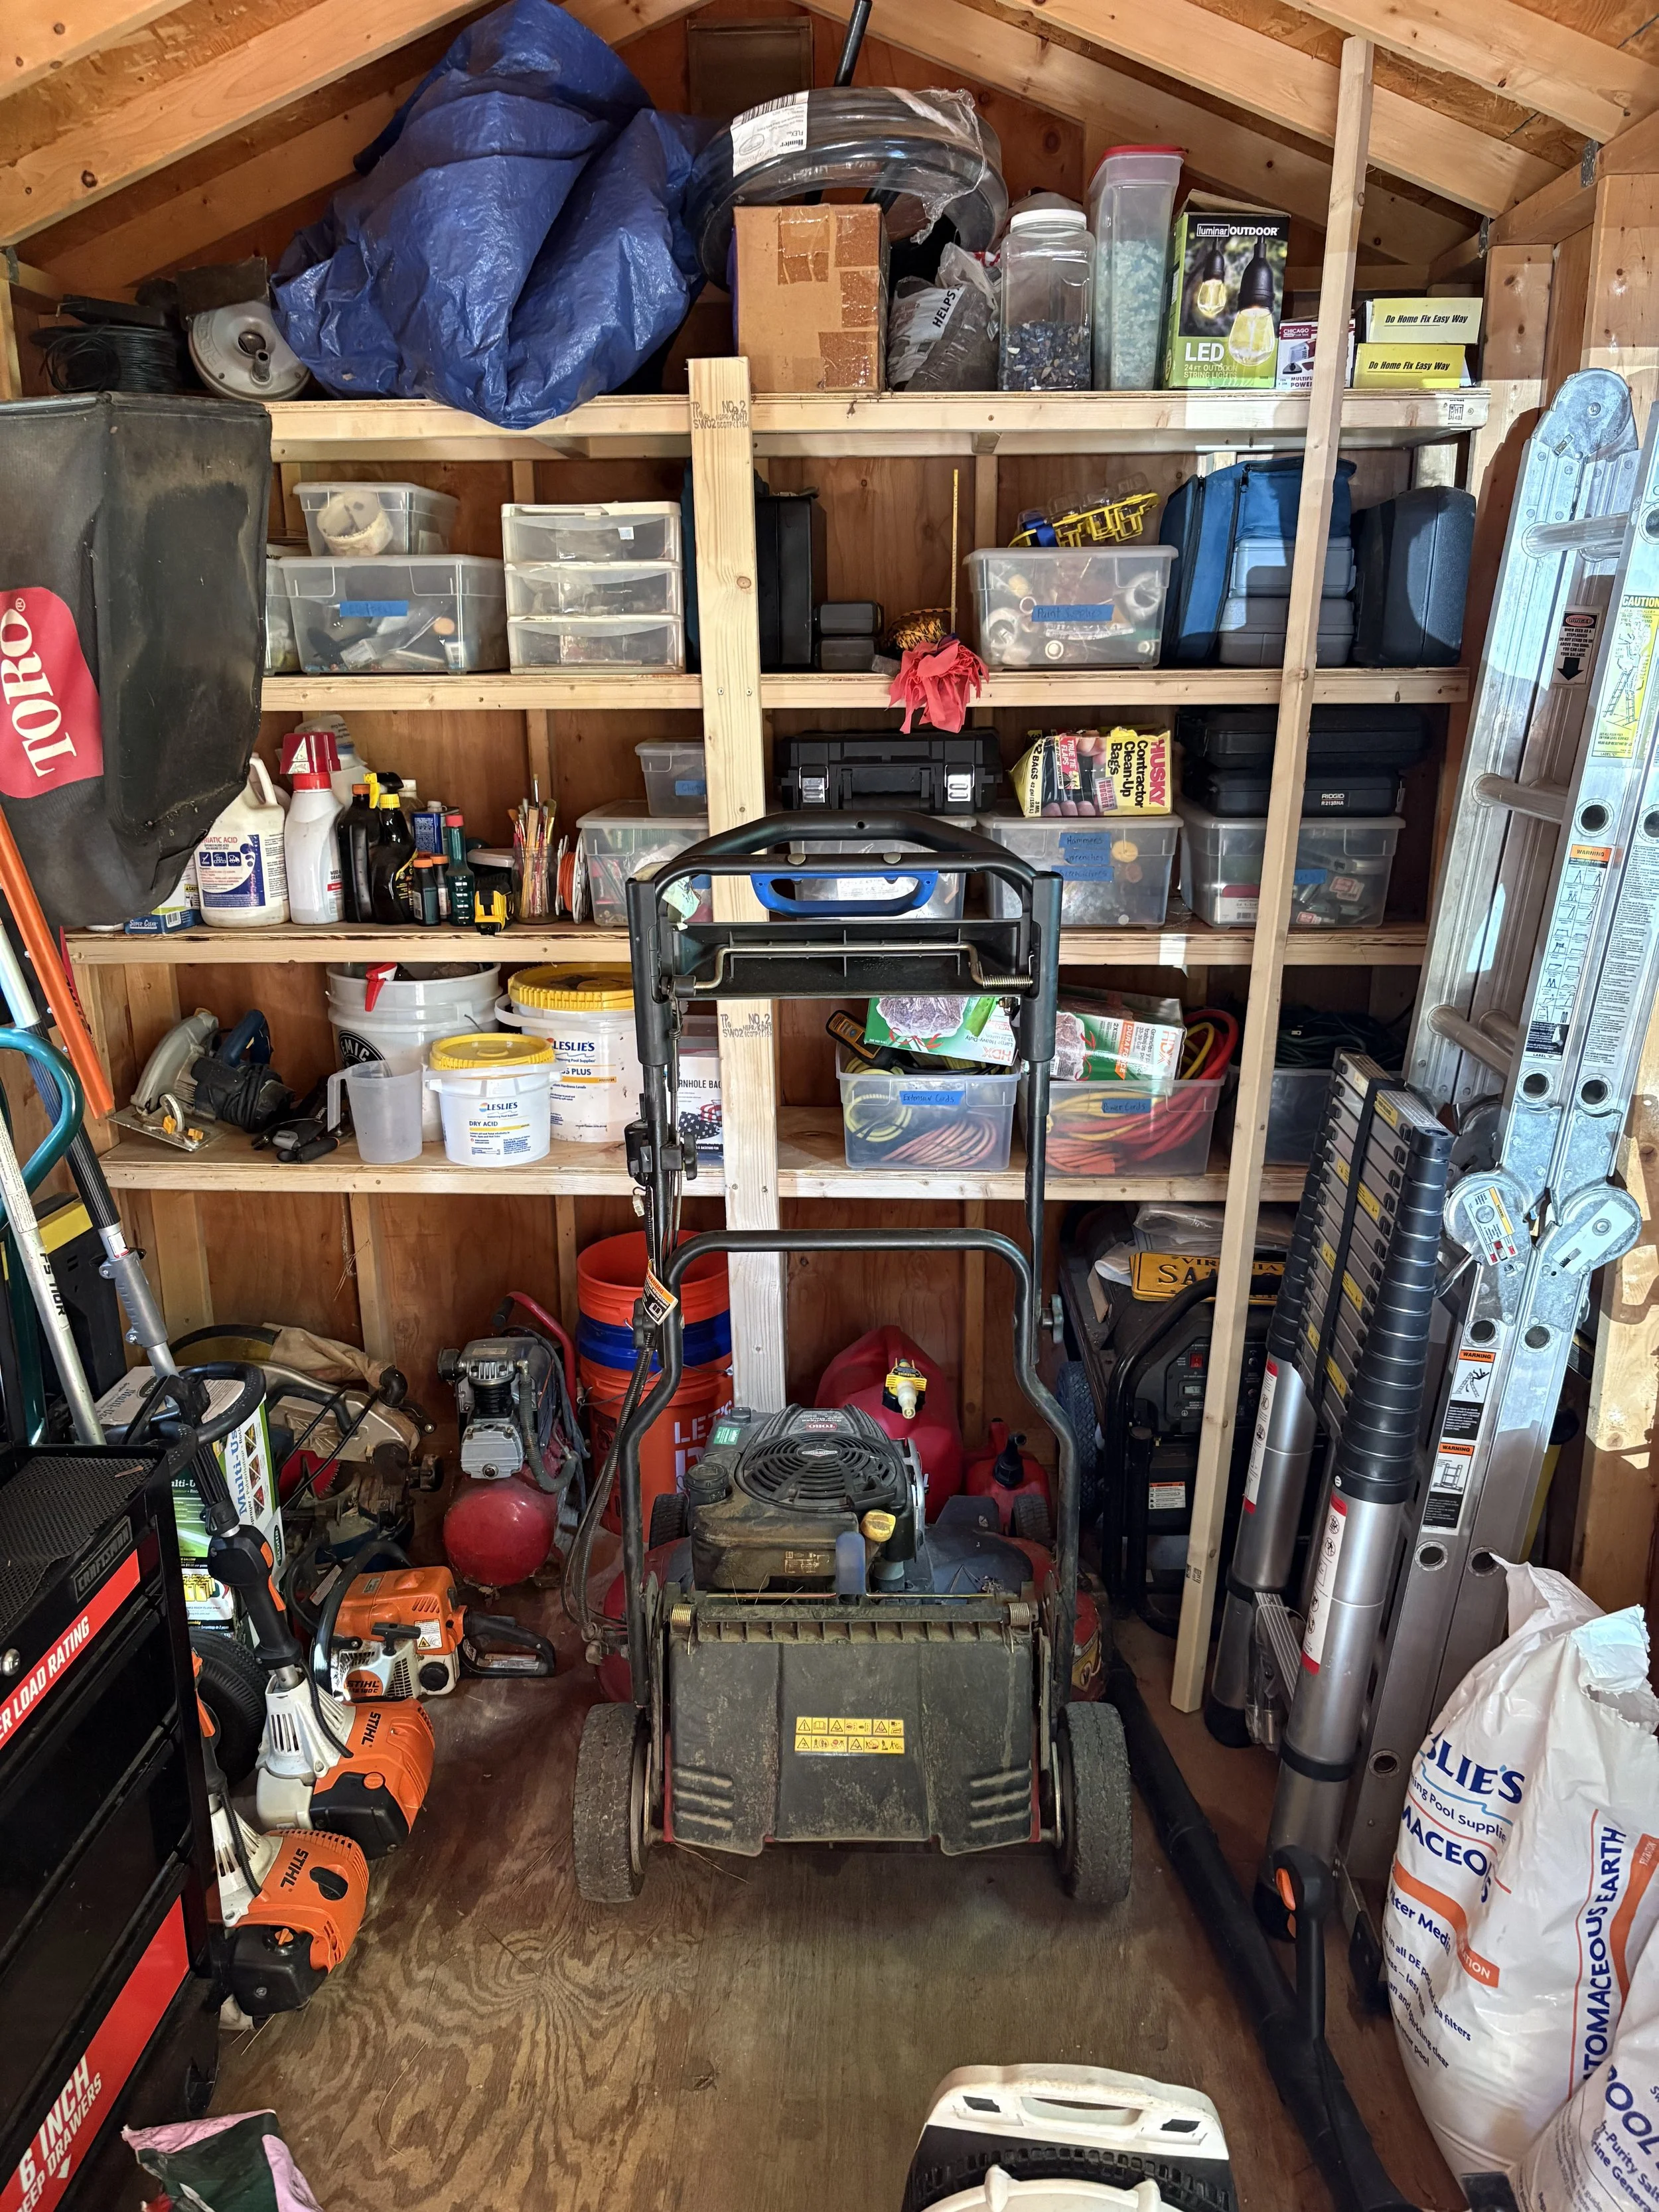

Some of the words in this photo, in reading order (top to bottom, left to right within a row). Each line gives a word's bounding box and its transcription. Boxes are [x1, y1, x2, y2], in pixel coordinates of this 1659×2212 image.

[1198, 226, 1228, 236] luminar
[1229, 226, 1278, 236] OUTDOOR
[932, 290, 956, 328] HELPS
[1433, 315, 1450, 324] Easy
[1451, 315, 1468, 324] Way
[1185, 342, 1224, 362] LED
[1415, 362, 1432, 370] Easy
[1433, 362, 1450, 371] Way
[1037, 607, 1062, 619] Paint
[1, 609, 77, 777] TORO
[1067, 740, 1076, 758] TRUE
[1108, 743, 1123, 775] Bags
[1030, 756, 1040, 780] BAGS
[1121, 741, 1135, 797] Clean-Up
[1135, 740, 1148, 808] Contractor
[1149, 739, 1165, 806] HUSKY
[1098, 781, 1109, 809] TOUGHER
[1067, 836, 1103, 845] Hammers
[1113, 1023, 1119, 1031] 2X
[1124, 1025, 1133, 1047] DURA
[553, 1041, 595, 1052] LESLIE'S
[965, 1036, 997, 1045] Heavy-Duty
[1140, 1029, 1149, 1051] trabajos
[1147, 1029, 1157, 1053] Grandes
[1157, 1031, 1177, 1068] HDX
[982, 1047, 1011, 1062] HDX
[934, 1093, 955, 1103] Cords
[1103, 1102, 1123, 1113] Power
[1125, 1102, 1146, 1112] Cords
[1463, 1351, 1492, 1360] WARNING
[77, 1528, 130, 1591] CRAFTSMAN
[13, 1667, 47, 1726] LOAD
[46, 1616, 90, 1679] RATING
[346, 1679, 379, 1688] STIHL
[361, 1712, 381, 1747] STIHL
[1429, 1794, 1455, 1819] Pool
[280, 1847, 309, 1888] STIHL
[1600, 1826, 1626, 1903] EARTH
[1396, 1943, 1407, 1958] all
[1407, 1952, 1420, 1969] DE
[1443, 2013, 1471, 2042] filters
[1398, 1992, 1411, 2010] and
[1432, 2045, 1449, 2069] clear
[1414, 2047, 1430, 2069] pool
[19, 2148, 36, 2193] 6
[38, 2055, 90, 2152] INCH
[46, 2071, 102, 2177] DRAWERS
